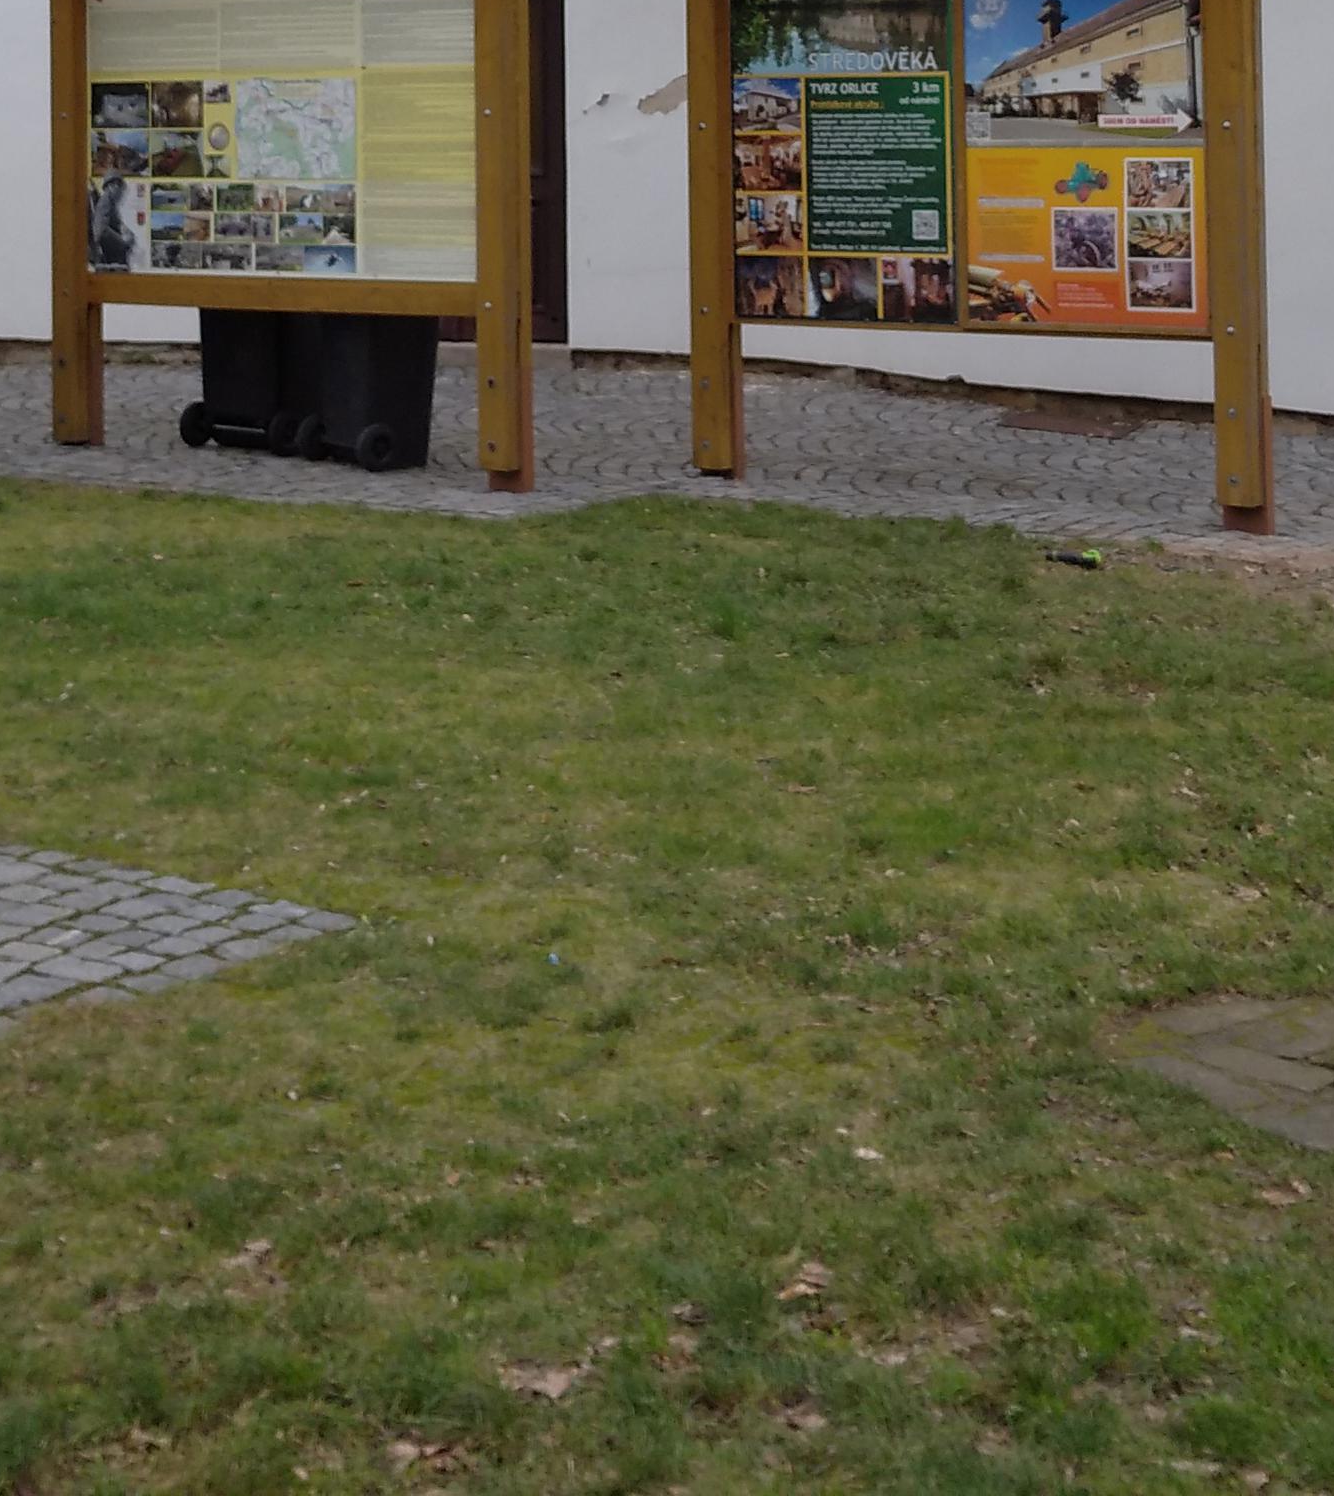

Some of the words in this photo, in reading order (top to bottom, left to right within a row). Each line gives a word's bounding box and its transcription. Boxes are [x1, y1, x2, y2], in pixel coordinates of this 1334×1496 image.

[809, 82, 838, 95] TVRZ
[839, 82, 880, 94] ORLICE
[912, 81, 920, 93] 3
[922, 81, 940, 93] km
